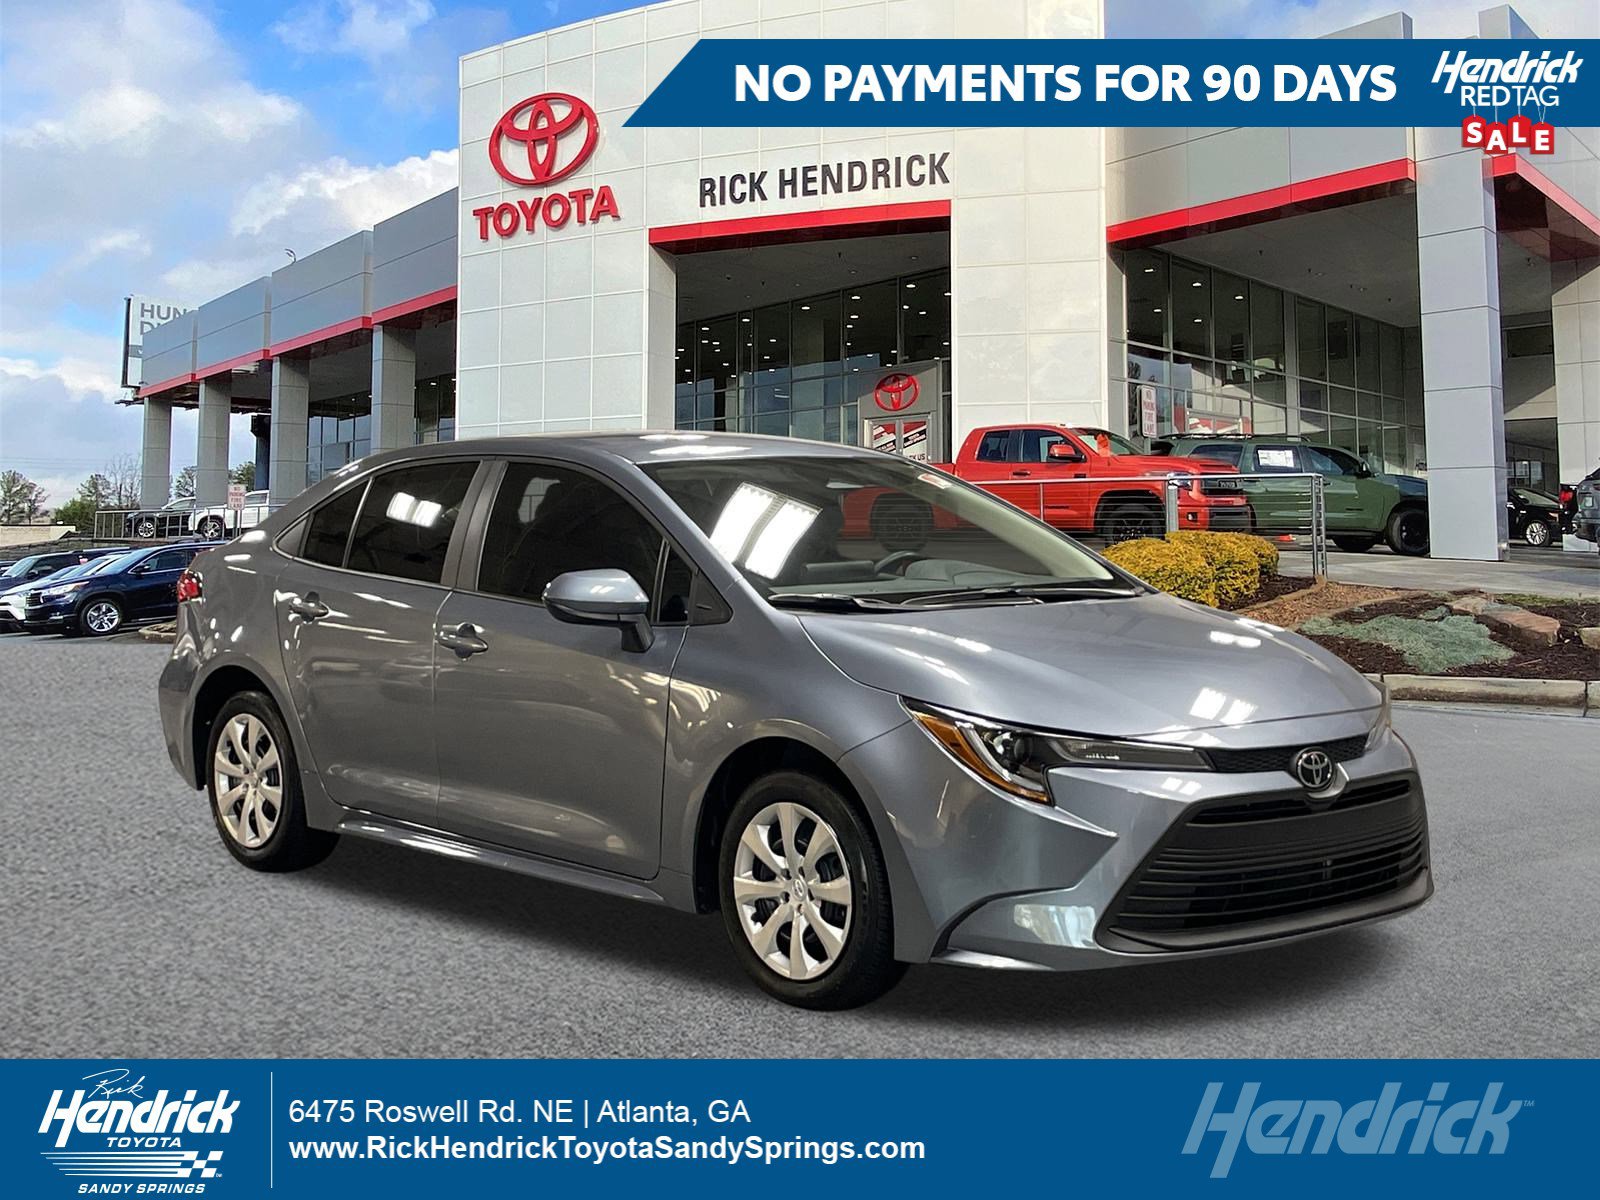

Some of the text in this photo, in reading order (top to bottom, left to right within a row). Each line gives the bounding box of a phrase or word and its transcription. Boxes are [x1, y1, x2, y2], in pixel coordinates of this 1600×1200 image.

[699, 152, 950, 208] RICK HENDRICK
[473, 185, 620, 241] TOYOTA
